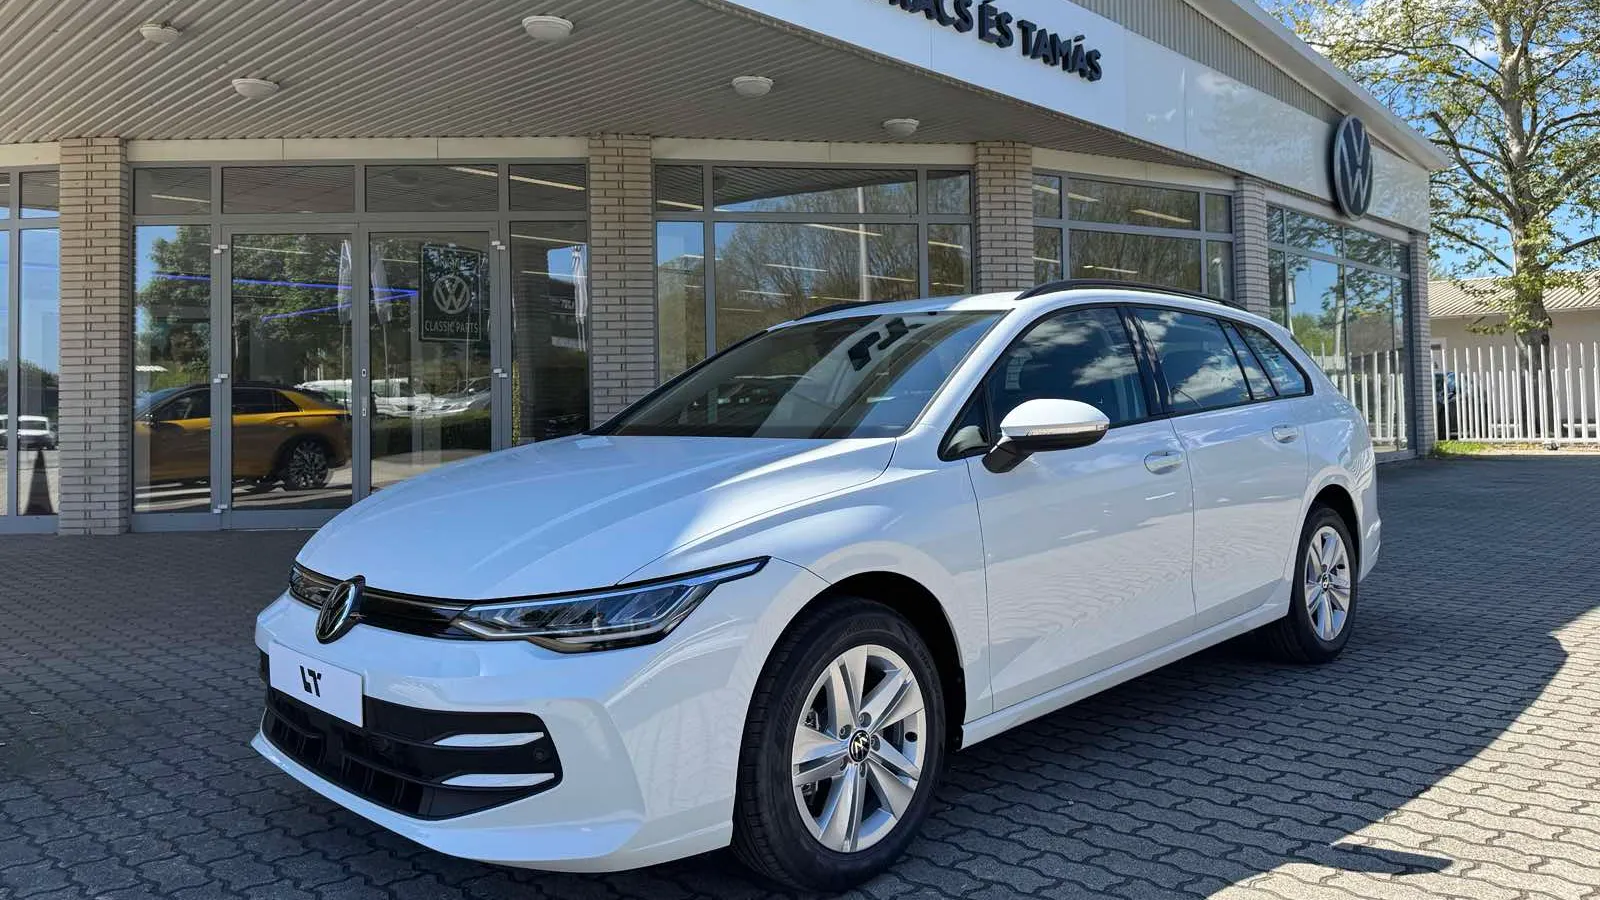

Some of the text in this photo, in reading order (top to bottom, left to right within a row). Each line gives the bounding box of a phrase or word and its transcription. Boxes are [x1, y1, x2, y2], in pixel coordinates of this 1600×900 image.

[978, 0, 1014, 48] ÉS
[1017, 19, 1102, 82] TAMÁS
[1334, 115, 1372, 219] VW
[433, 275, 470, 314] VW
[424, 320, 454, 333] CLASSIC
[300, 665, 322, 698] LT
